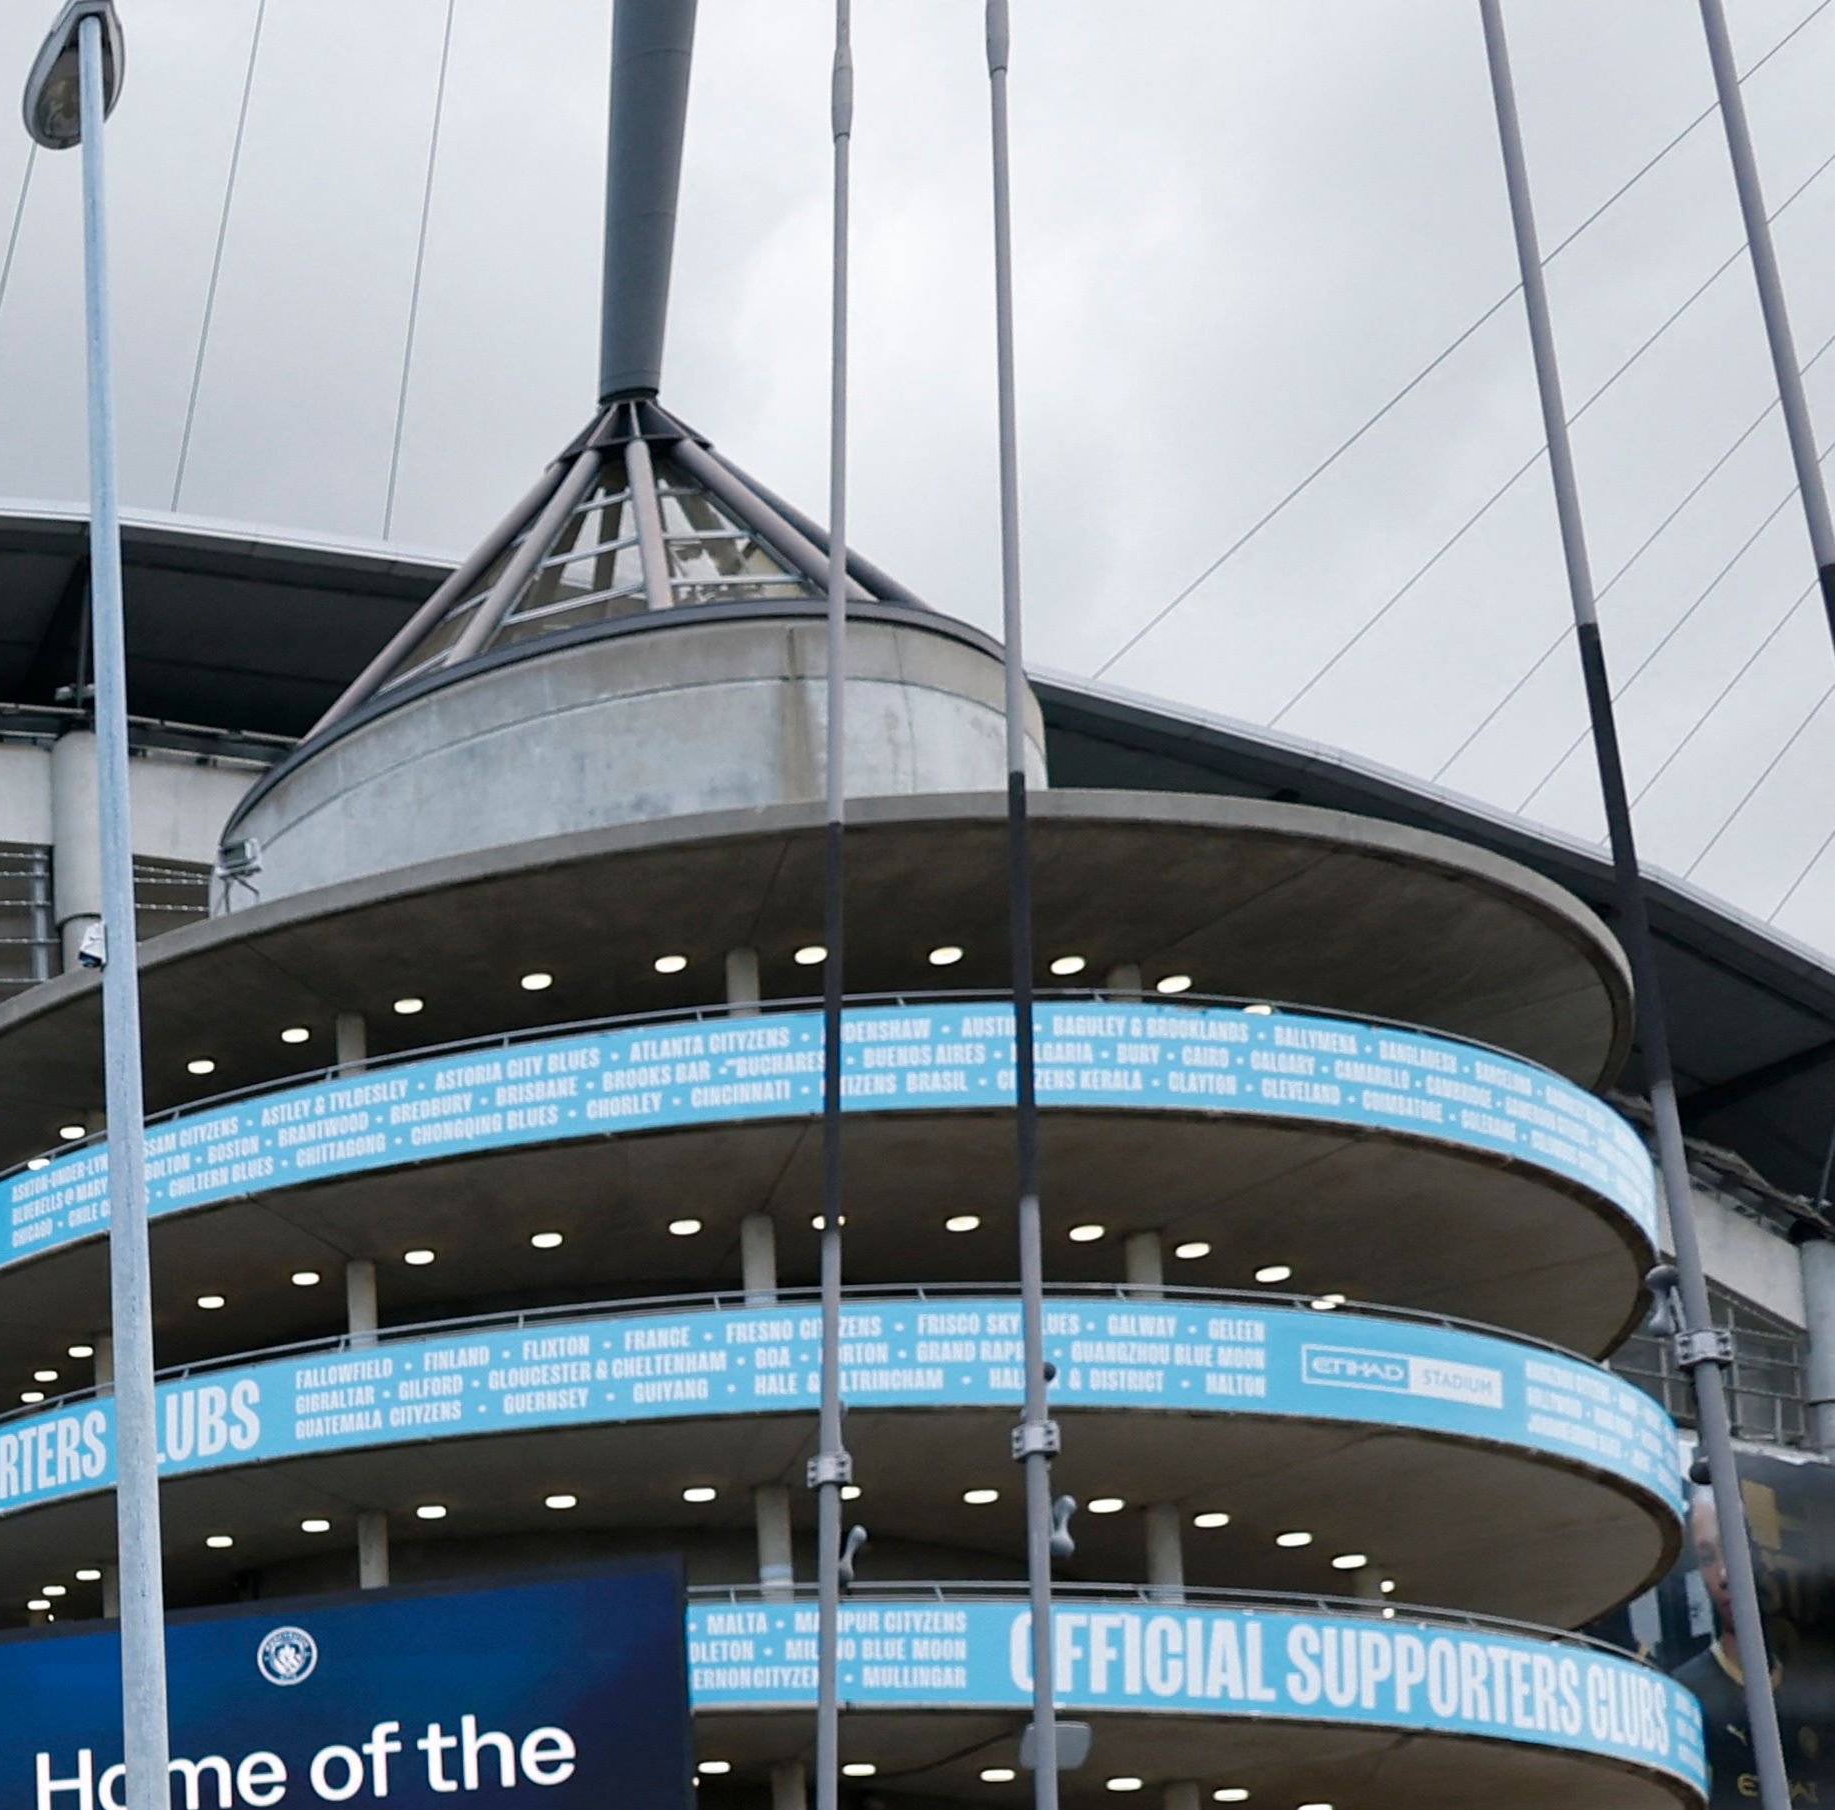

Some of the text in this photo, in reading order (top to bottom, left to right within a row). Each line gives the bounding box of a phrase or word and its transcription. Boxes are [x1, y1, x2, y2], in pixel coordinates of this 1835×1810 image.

[208, 1042, 1160, 1164] BOSTON BRISBANE BROOKS BAR AIRES BURY
[261, 1027, 790, 1127] ASTLEY TYLDESLEY ASTORIA CITY BLUES ATLANTA CITYZENS
[232, 1070, 1143, 1185] BLUES BLUES BRASIL KERALA
[296, 1315, 1177, 1390] FALLOWFIELD FINLAND FLIXTON FRANCE FRESNO FRISCO GALWAY
[296, 1342, 975, 1415] GIBRALTAR GILFORD GLOUCESTER & CHELTENHAM GOA GRAND
[1311, 1357, 1492, 1397] ETIHAD STADIUM
[296, 1373, 799, 1440] GUATEMALA CITYZENS GUERNSEY HALE
[707, 1610, 968, 1635] MALTA CITYZENS
[862, 1638, 906, 1661] BLUE
[1010, 1611, 1276, 1702] OFFICIAL
[1285, 1622, 1582, 1739] SUPPORTERS
[1586, 1665, 1670, 1757] CLUBS
[310, 1721, 401, 1802] of
[417, 1714, 577, 1794] the
